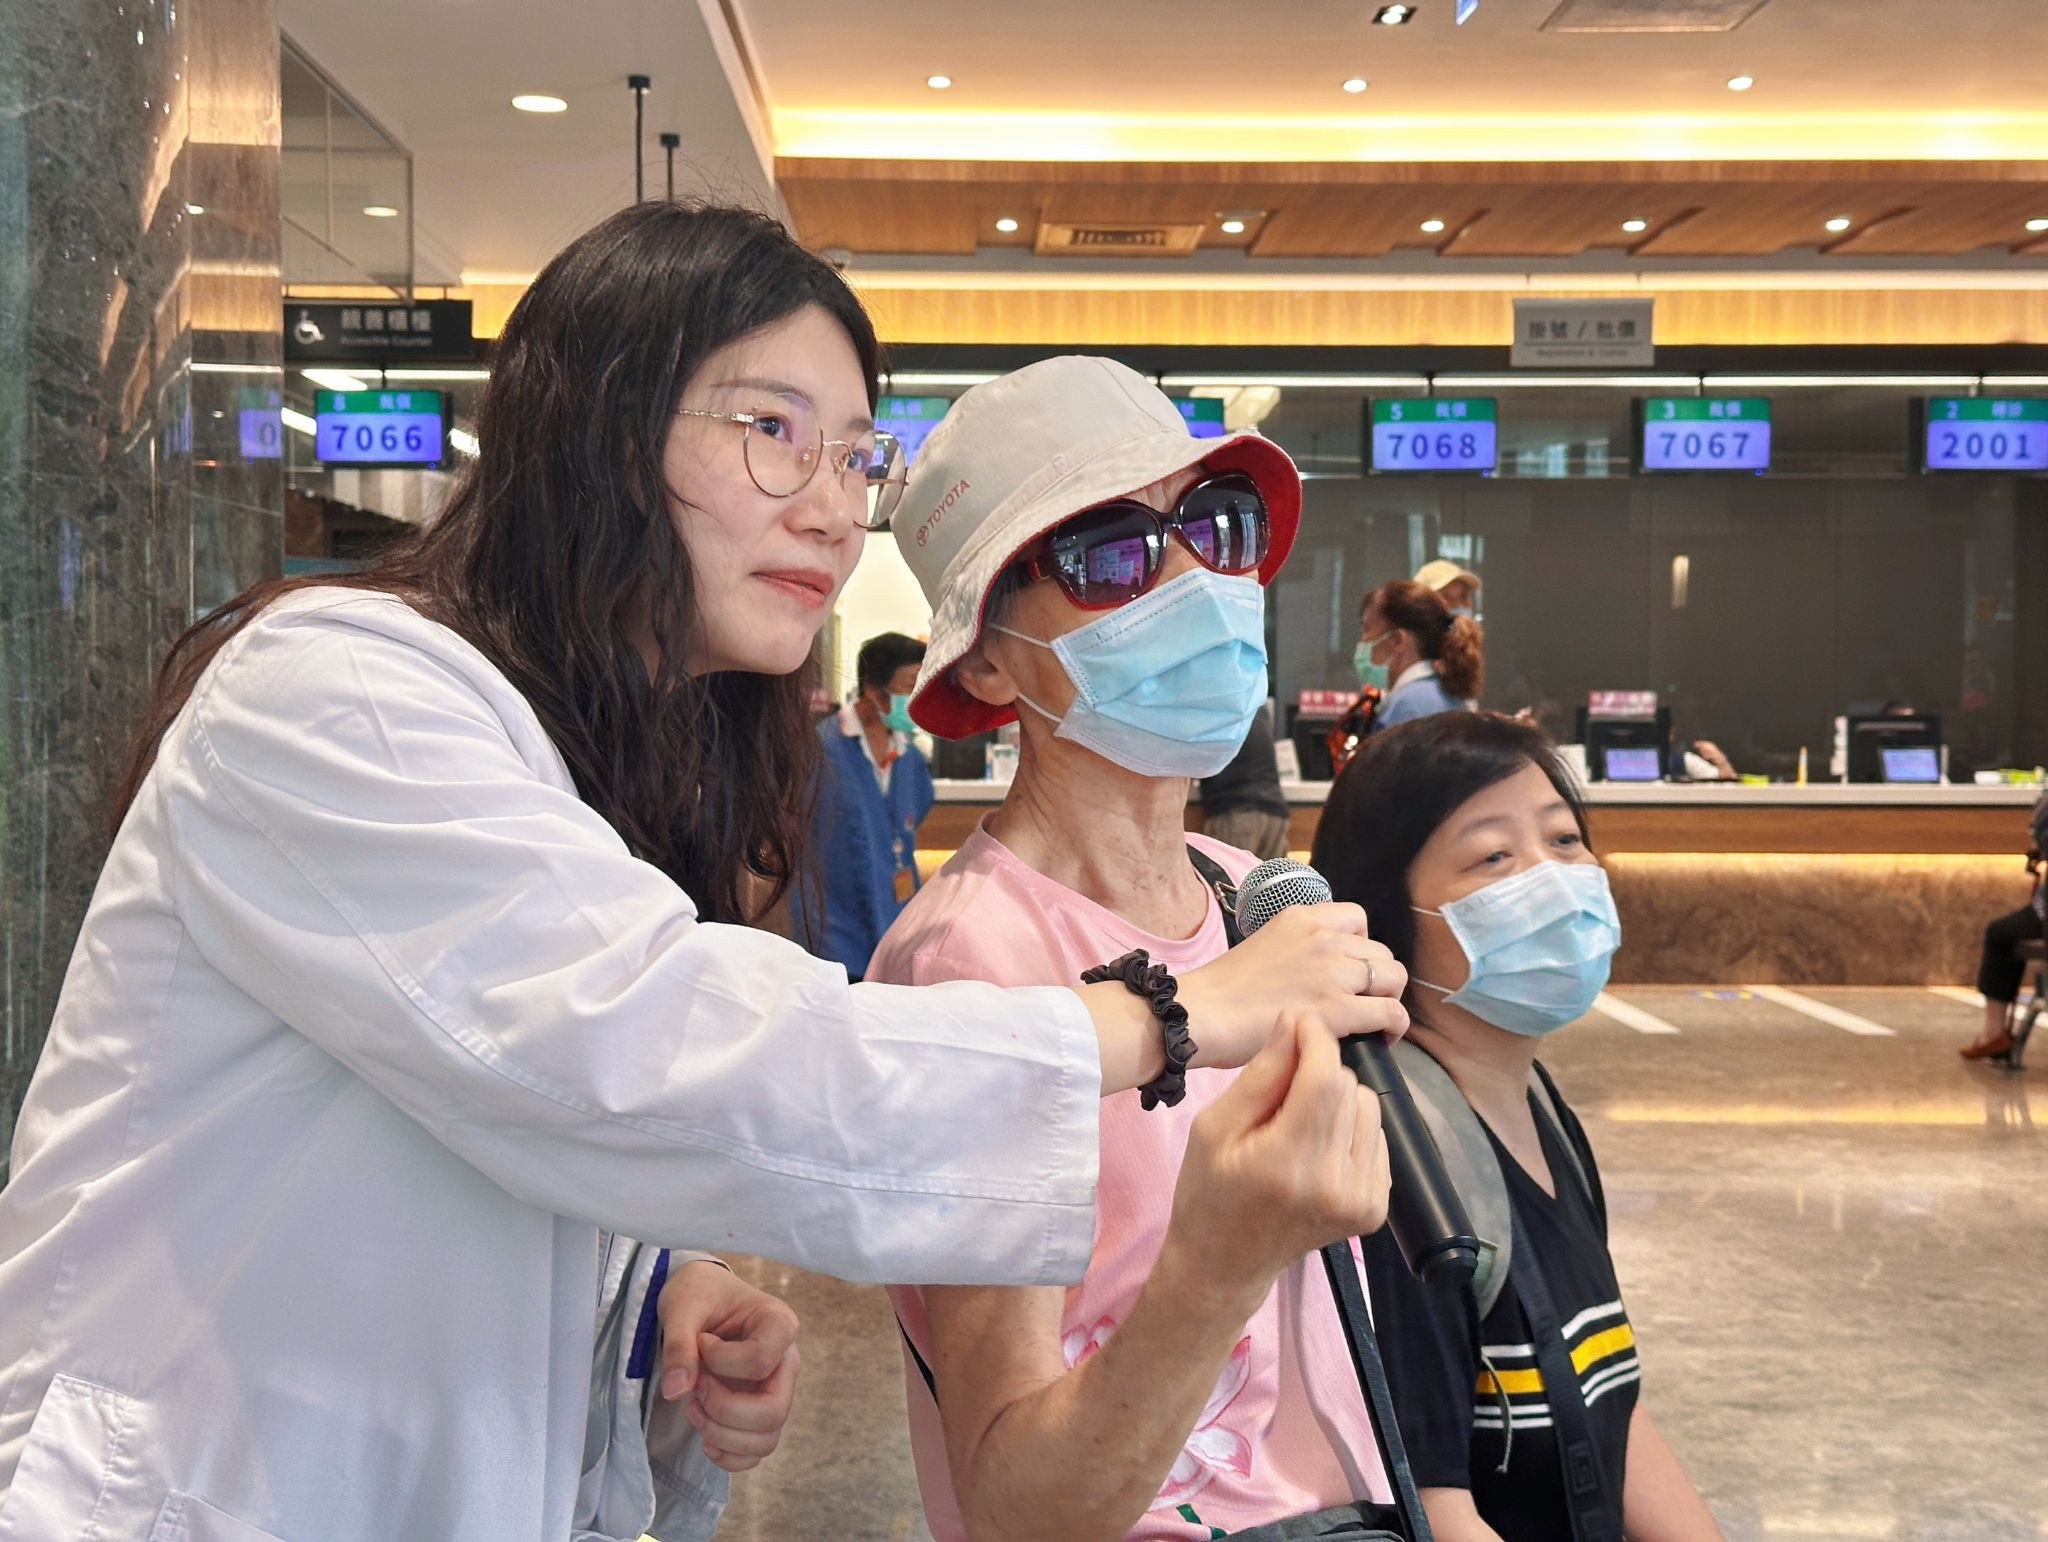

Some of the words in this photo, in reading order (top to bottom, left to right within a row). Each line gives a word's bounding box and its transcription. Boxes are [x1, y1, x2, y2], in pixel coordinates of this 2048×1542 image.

[331, 425, 422, 451] 7066
[1387, 433, 1476, 459] 7068
[1660, 432, 1750, 458] 7067
[1942, 433, 2031, 459] 2001
[928, 480, 970, 528] TOYOTA
